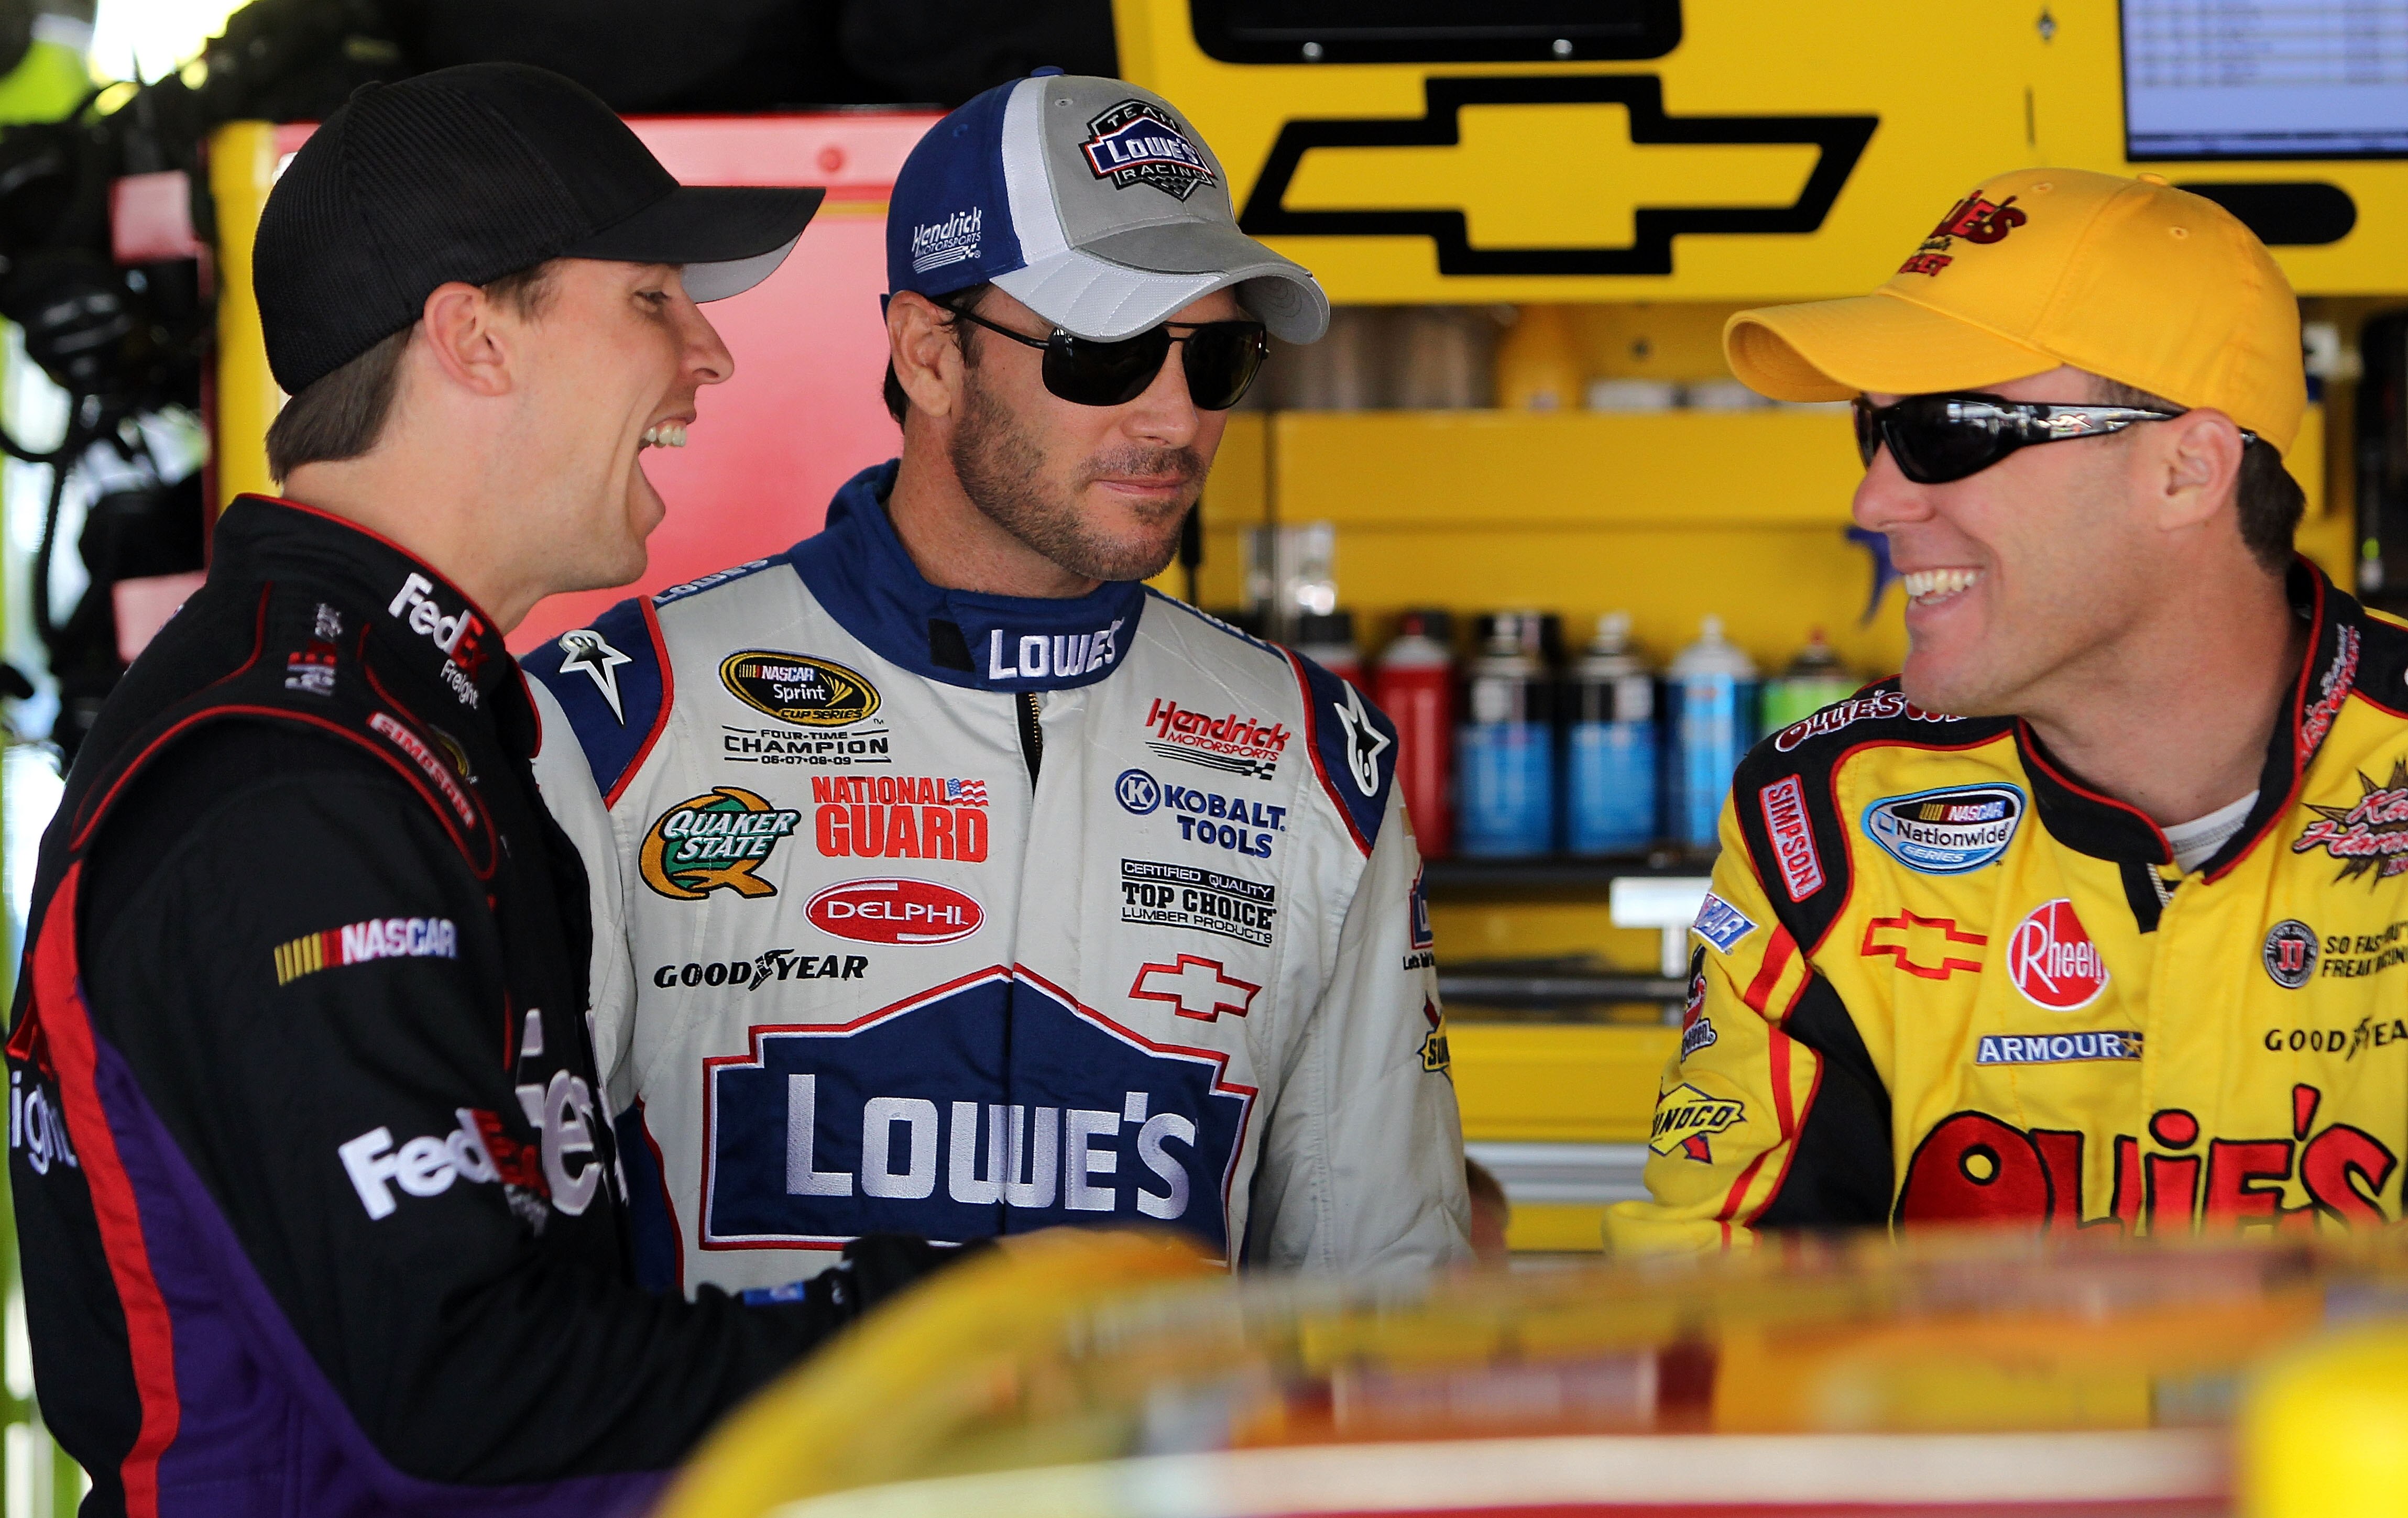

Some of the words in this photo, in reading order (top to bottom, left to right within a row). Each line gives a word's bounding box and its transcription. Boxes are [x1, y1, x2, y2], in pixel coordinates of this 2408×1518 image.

[1108, 107, 1176, 129] TEAM
[1106, 137, 1198, 164] LOWE'S
[1122, 164, 1205, 180] RACING
[911, 206, 982, 257] Hendrick
[918, 232, 981, 257] MOTORSPORTS
[388, 573, 489, 673] FedEx
[989, 617, 1125, 680] LOWE'S
[441, 659, 479, 710] Freight
[762, 665, 814, 681] NASCAR
[773, 683, 826, 702] Sprint
[780, 709, 811, 719] CUP
[813, 708, 863, 720] SERIES
[1145, 697, 1290, 752] Hendrick
[724, 734, 889, 754] CHAMPION
[1168, 732, 1279, 762] MOTORSPORTS
[812, 776, 949, 805] NATIONAL
[1164, 783, 1286, 830] KOBALT
[1947, 800, 2006, 821] NASCAR
[663, 810, 800, 838] QUAKER
[815, 804, 988, 863] GUARD
[1177, 815, 1273, 858] TOOLS
[1768, 782, 1817, 890] SIMPSON
[1897, 820, 2008, 846] Nationwide
[677, 835, 773, 860] STATE
[1903, 845, 1966, 862] SERIES
[1124, 861, 1201, 882] CERTIFIED
[1208, 874, 1271, 898] QUALITY
[827, 900, 965, 925] DELPHI
[1122, 881, 1174, 908] TOP
[1183, 888, 1275, 930] CHOICE
[1122, 907, 1188, 923] LUMBER
[1194, 914, 1273, 944] PRODUCTS
[341, 917, 457, 965] NASCAR
[2325, 936, 2350, 954] SO
[653, 949, 869, 991] GOODYEAR
[1979, 1032, 2122, 1063] ARMOUR
[786, 1074, 1196, 1219] LOWE'S
[338, 1107, 551, 1221] FedEx
